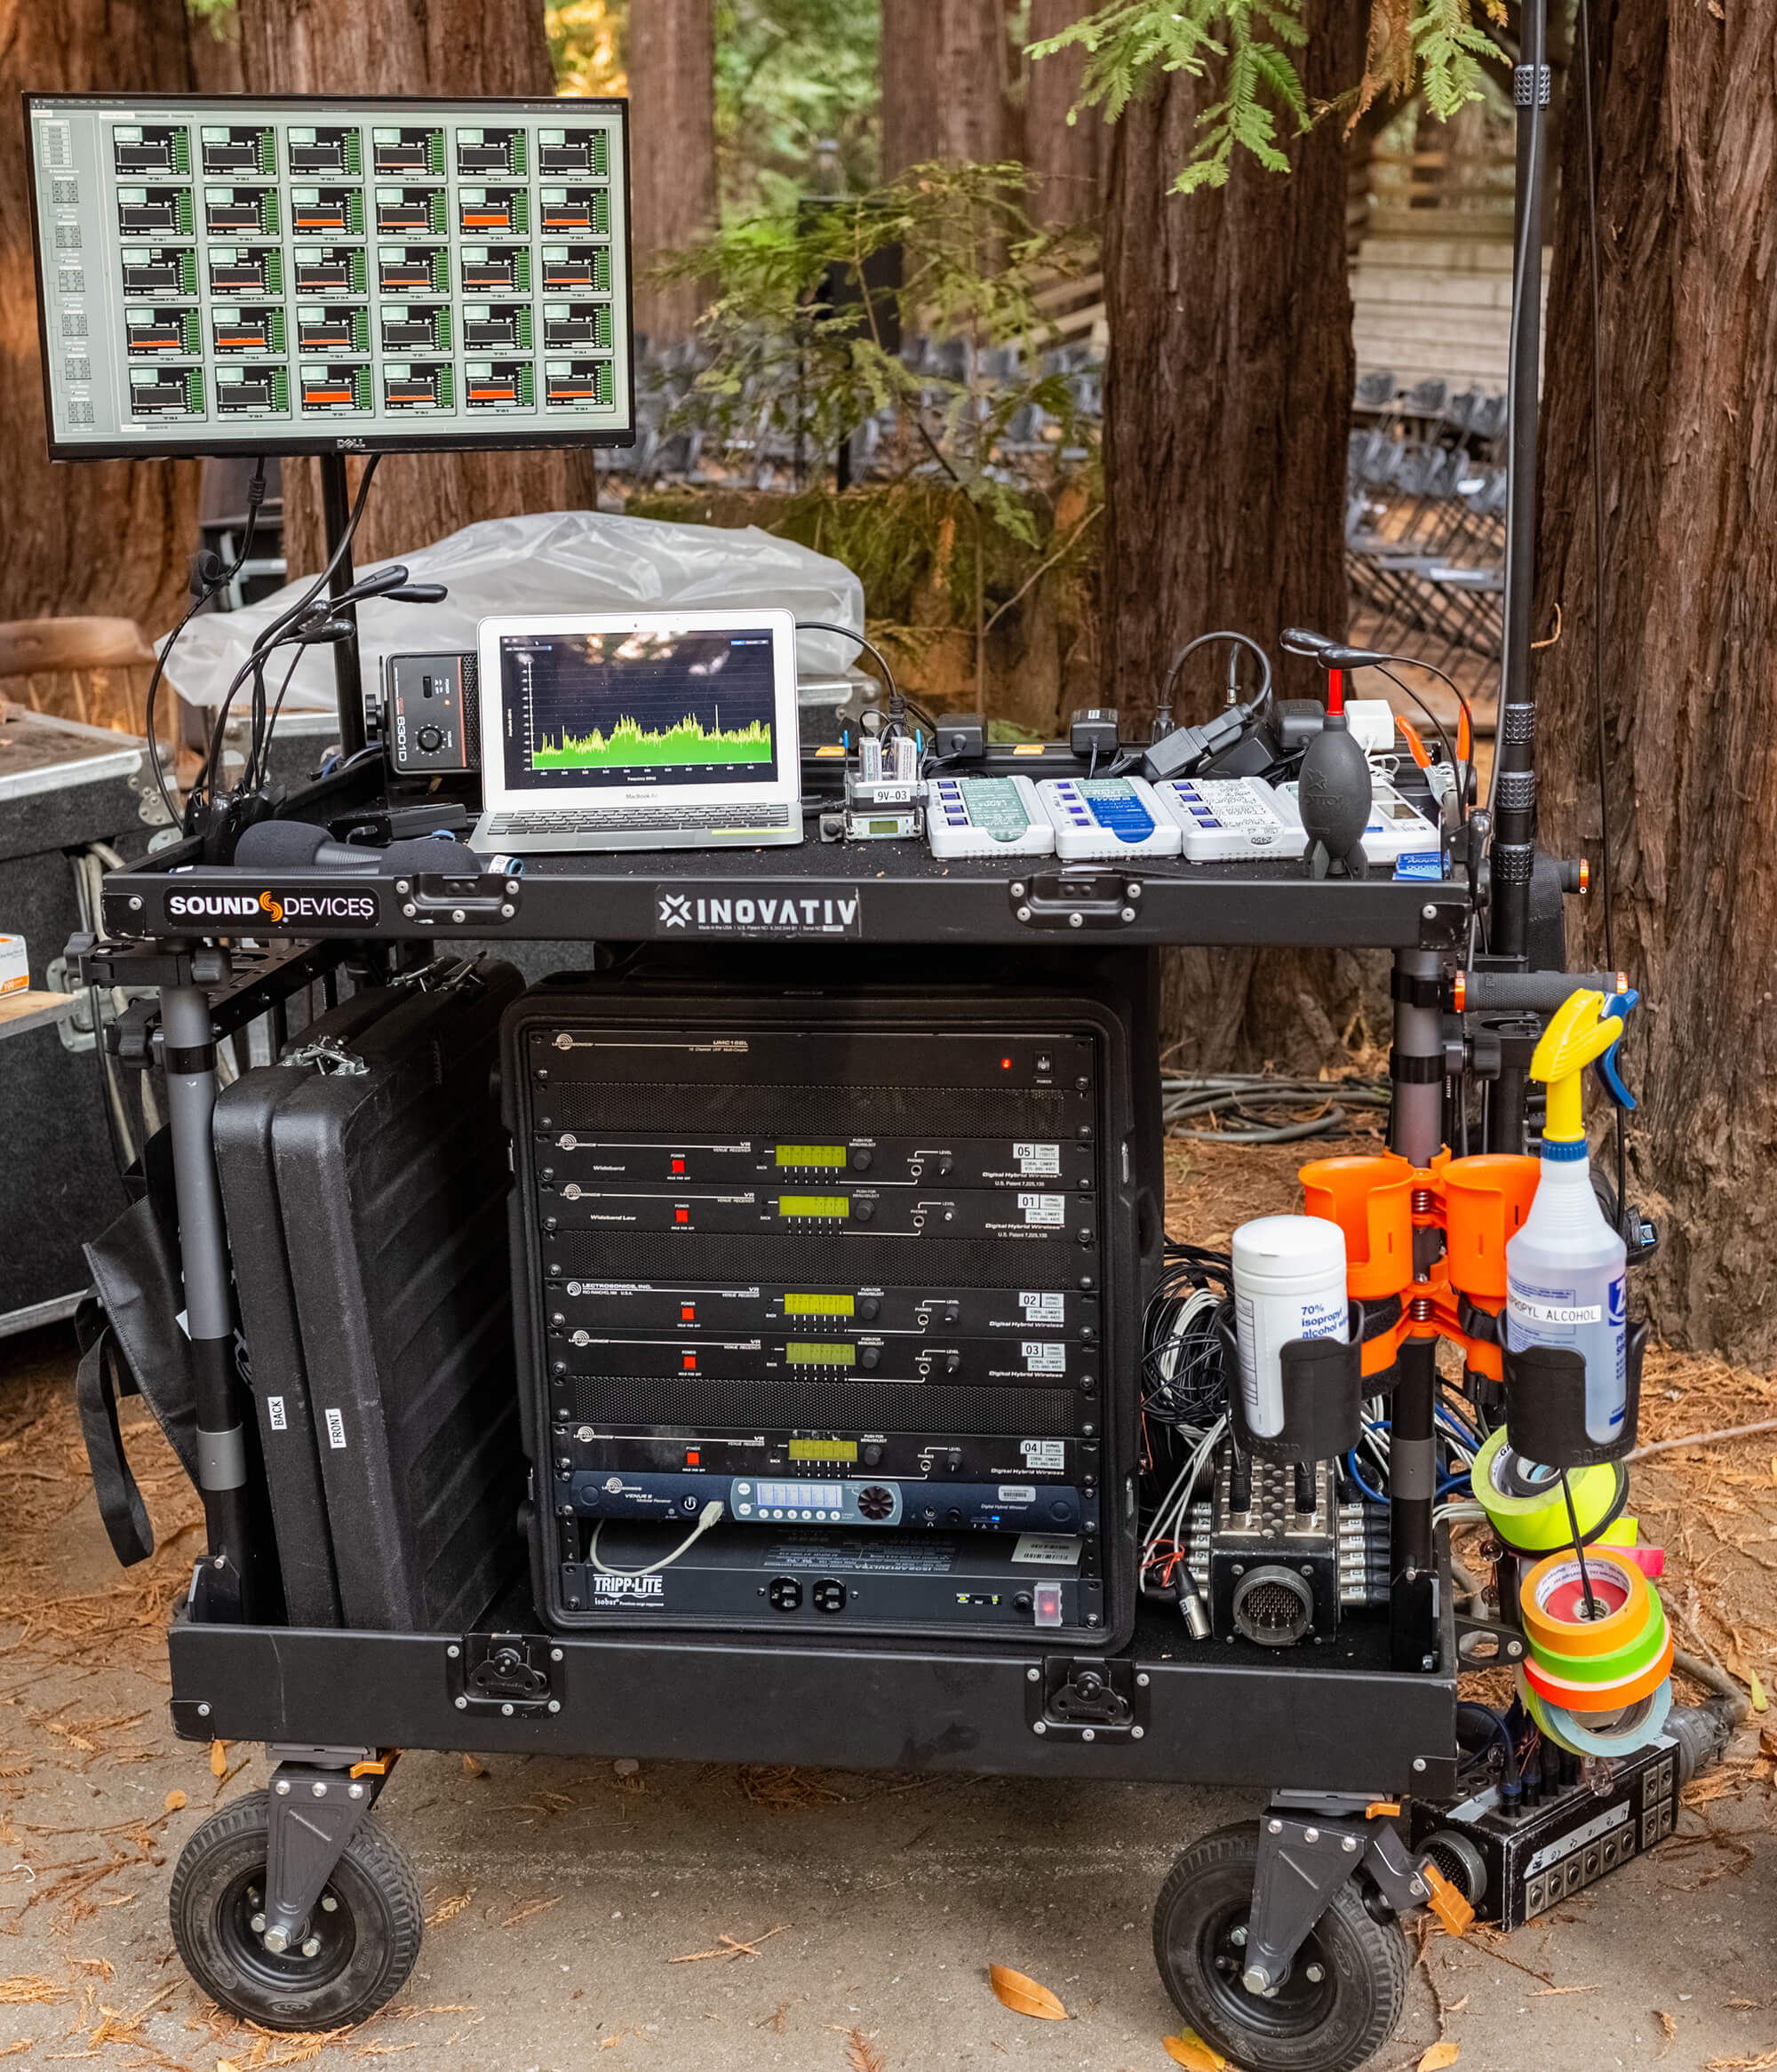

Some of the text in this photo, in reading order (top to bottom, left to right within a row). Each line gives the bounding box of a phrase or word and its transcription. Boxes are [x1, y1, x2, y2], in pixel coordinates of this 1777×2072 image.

[337, 438, 366, 449] DELL
[878, 790, 907, 801] 9V-03
[170, 896, 374, 917] SOUND DEVICES
[697, 898, 857, 924] INOVATIV
[1017, 1146, 1031, 1157] 05
[1023, 1197, 1034, 1207] 01
[1024, 1295, 1037, 1305] 02
[1301, 1303, 1325, 1316] 70%
[1302, 1307, 1343, 1327] isopropyl
[1546, 1310, 1597, 1322] ALCOHOL
[1303, 1321, 1337, 1339] alcohol
[1025, 1345, 1039, 1355] 03
[271, 1400, 284, 1426] BACK
[329, 1414, 343, 1444] FRONT
[1024, 1442, 1038, 1453] 04
